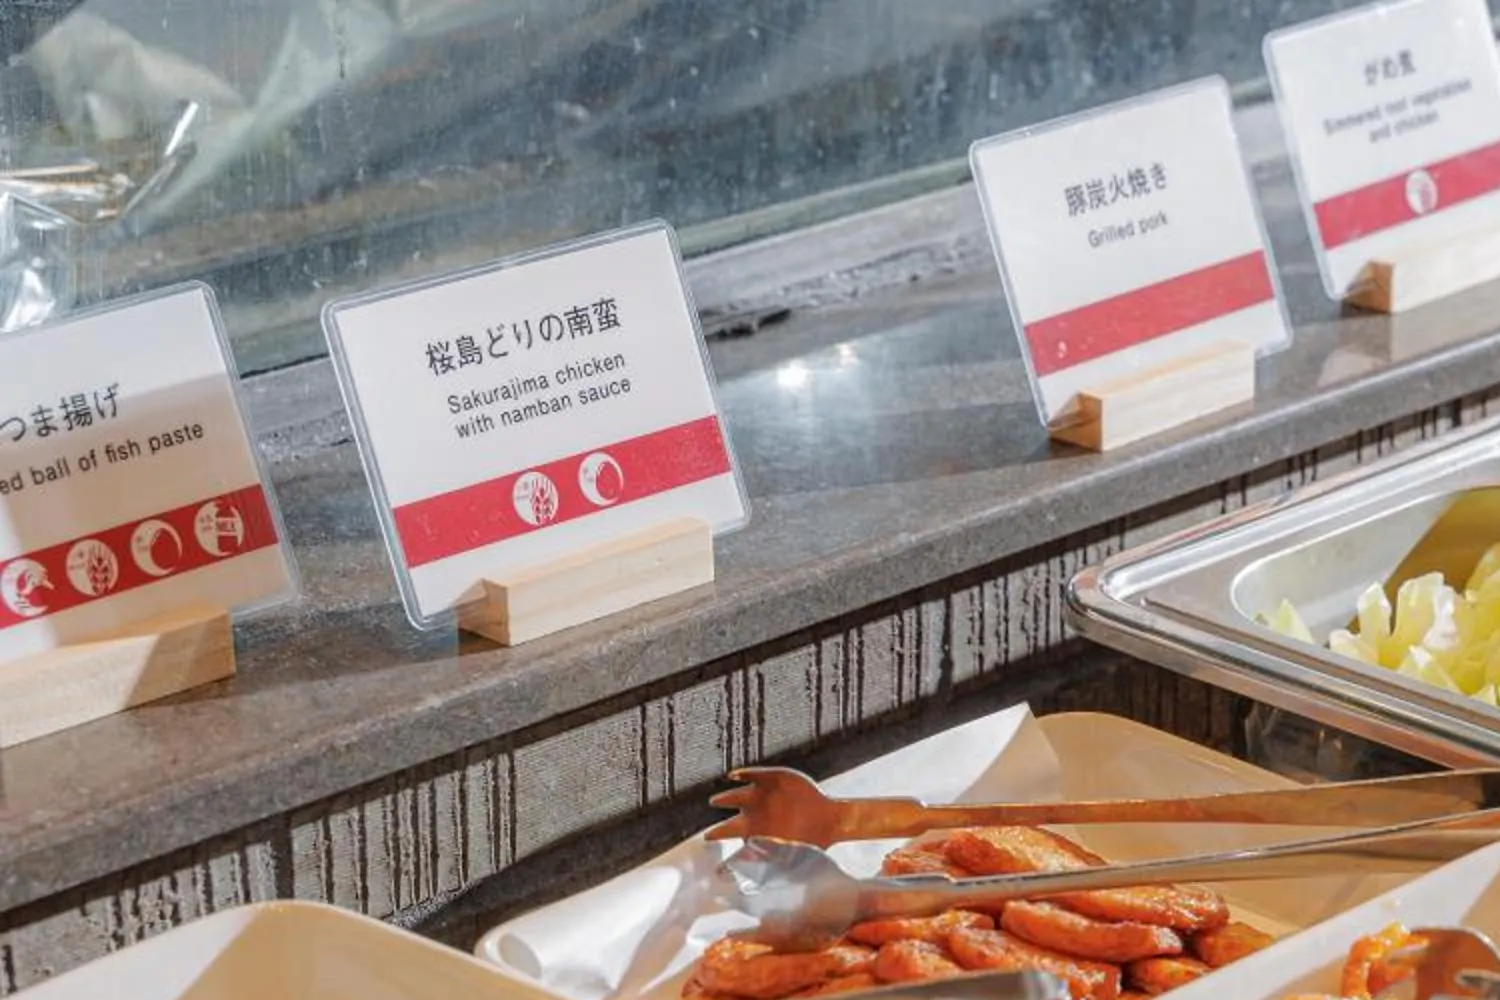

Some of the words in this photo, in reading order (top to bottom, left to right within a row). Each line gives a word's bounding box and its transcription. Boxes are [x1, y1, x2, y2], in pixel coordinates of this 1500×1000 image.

[1064, 161, 1167, 217] 豚炭火焼き
[1088, 221, 1136, 248] Grilled
[1138, 210, 1168, 235] pork
[425, 297, 621, 376] 桜島どりの南蛮
[447, 374, 549, 414] Sakurajima
[555, 352, 625, 385] chicken
[455, 413, 494, 439] with
[500, 393, 573, 427] namban
[578, 378, 631, 405] sauce
[31, 459, 71, 486] ball
[78, 449, 98, 472] of
[105, 439, 142, 463] fish
[149, 423, 204, 455] paste
